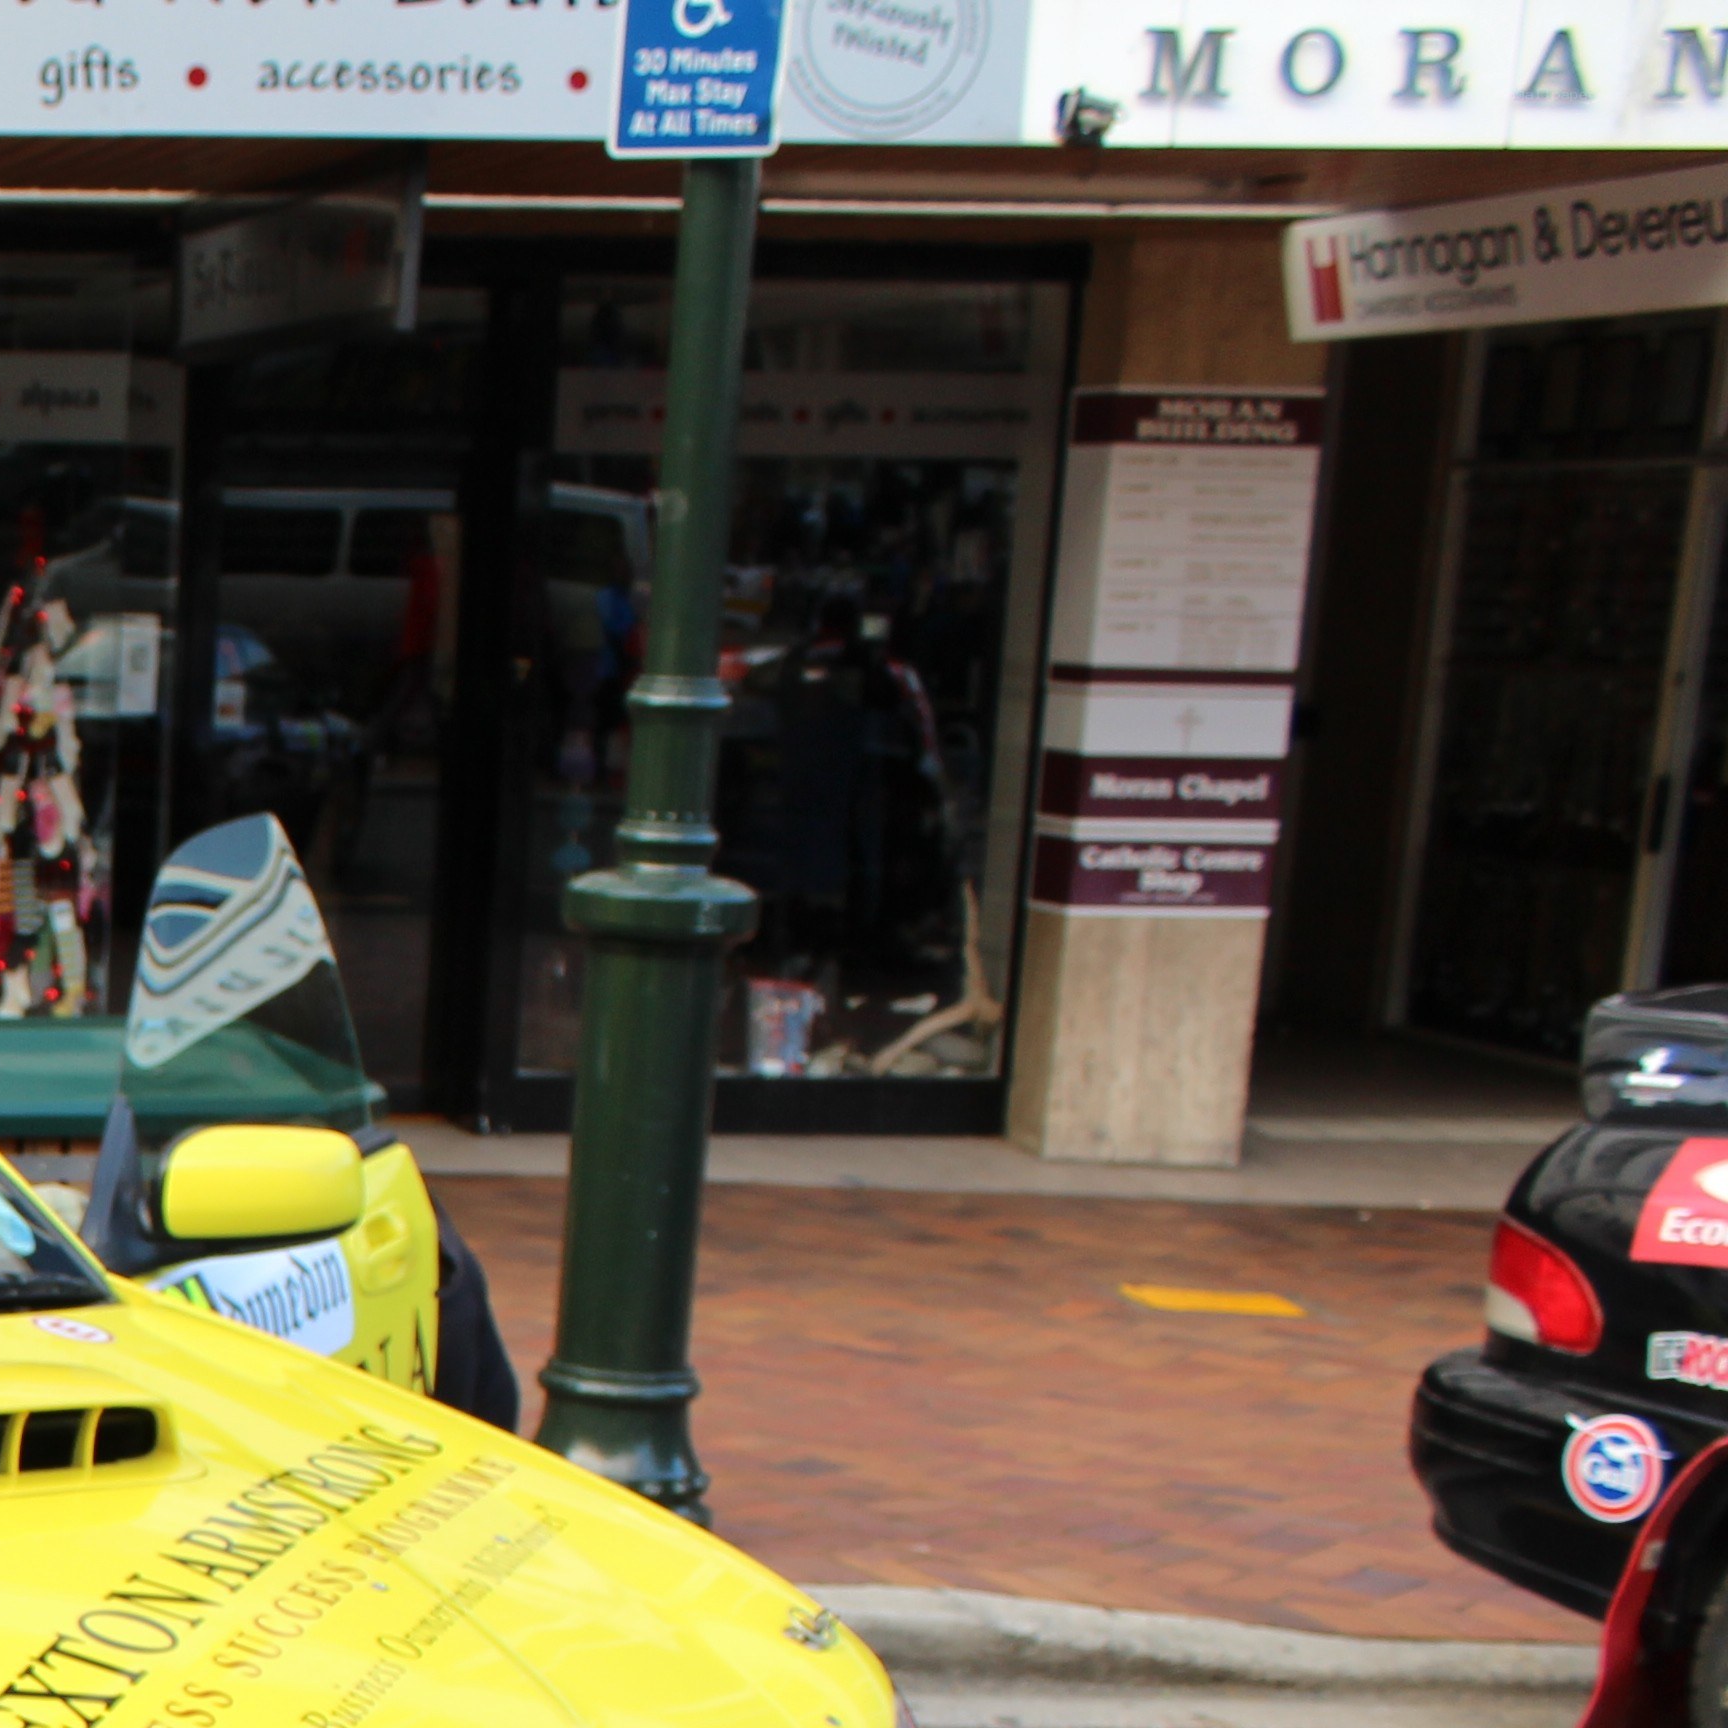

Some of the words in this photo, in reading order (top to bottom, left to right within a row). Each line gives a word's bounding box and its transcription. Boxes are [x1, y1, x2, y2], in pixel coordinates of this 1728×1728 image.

[39, 45, 140, 106] gifts
[257, 53, 523, 93] accessories
[668, 46, 758, 75] Minutes
[1140, 27, 1728, 100] MORAN
[645, 78, 693, 106] Max
[695, 76, 748, 109] Stay
[628, 109, 657, 138] At
[658, 109, 691, 138] All
[695, 107, 759, 137] Times
[1348, 222, 1525, 288] Hannagan
[1533, 205, 1563, 264] &
[1156, 399, 1284, 419] MORAN
[1136, 418, 1299, 442] BUILDING
[1176, 773, 1271, 807] Chapel
[1078, 845, 1182, 871] Catholic
[159, 1422, 445, 1595] ARMSTRONG
[212, 1557, 370, 1680] SUCCESS
[353, 1453, 519, 1567] PROGRAMME
